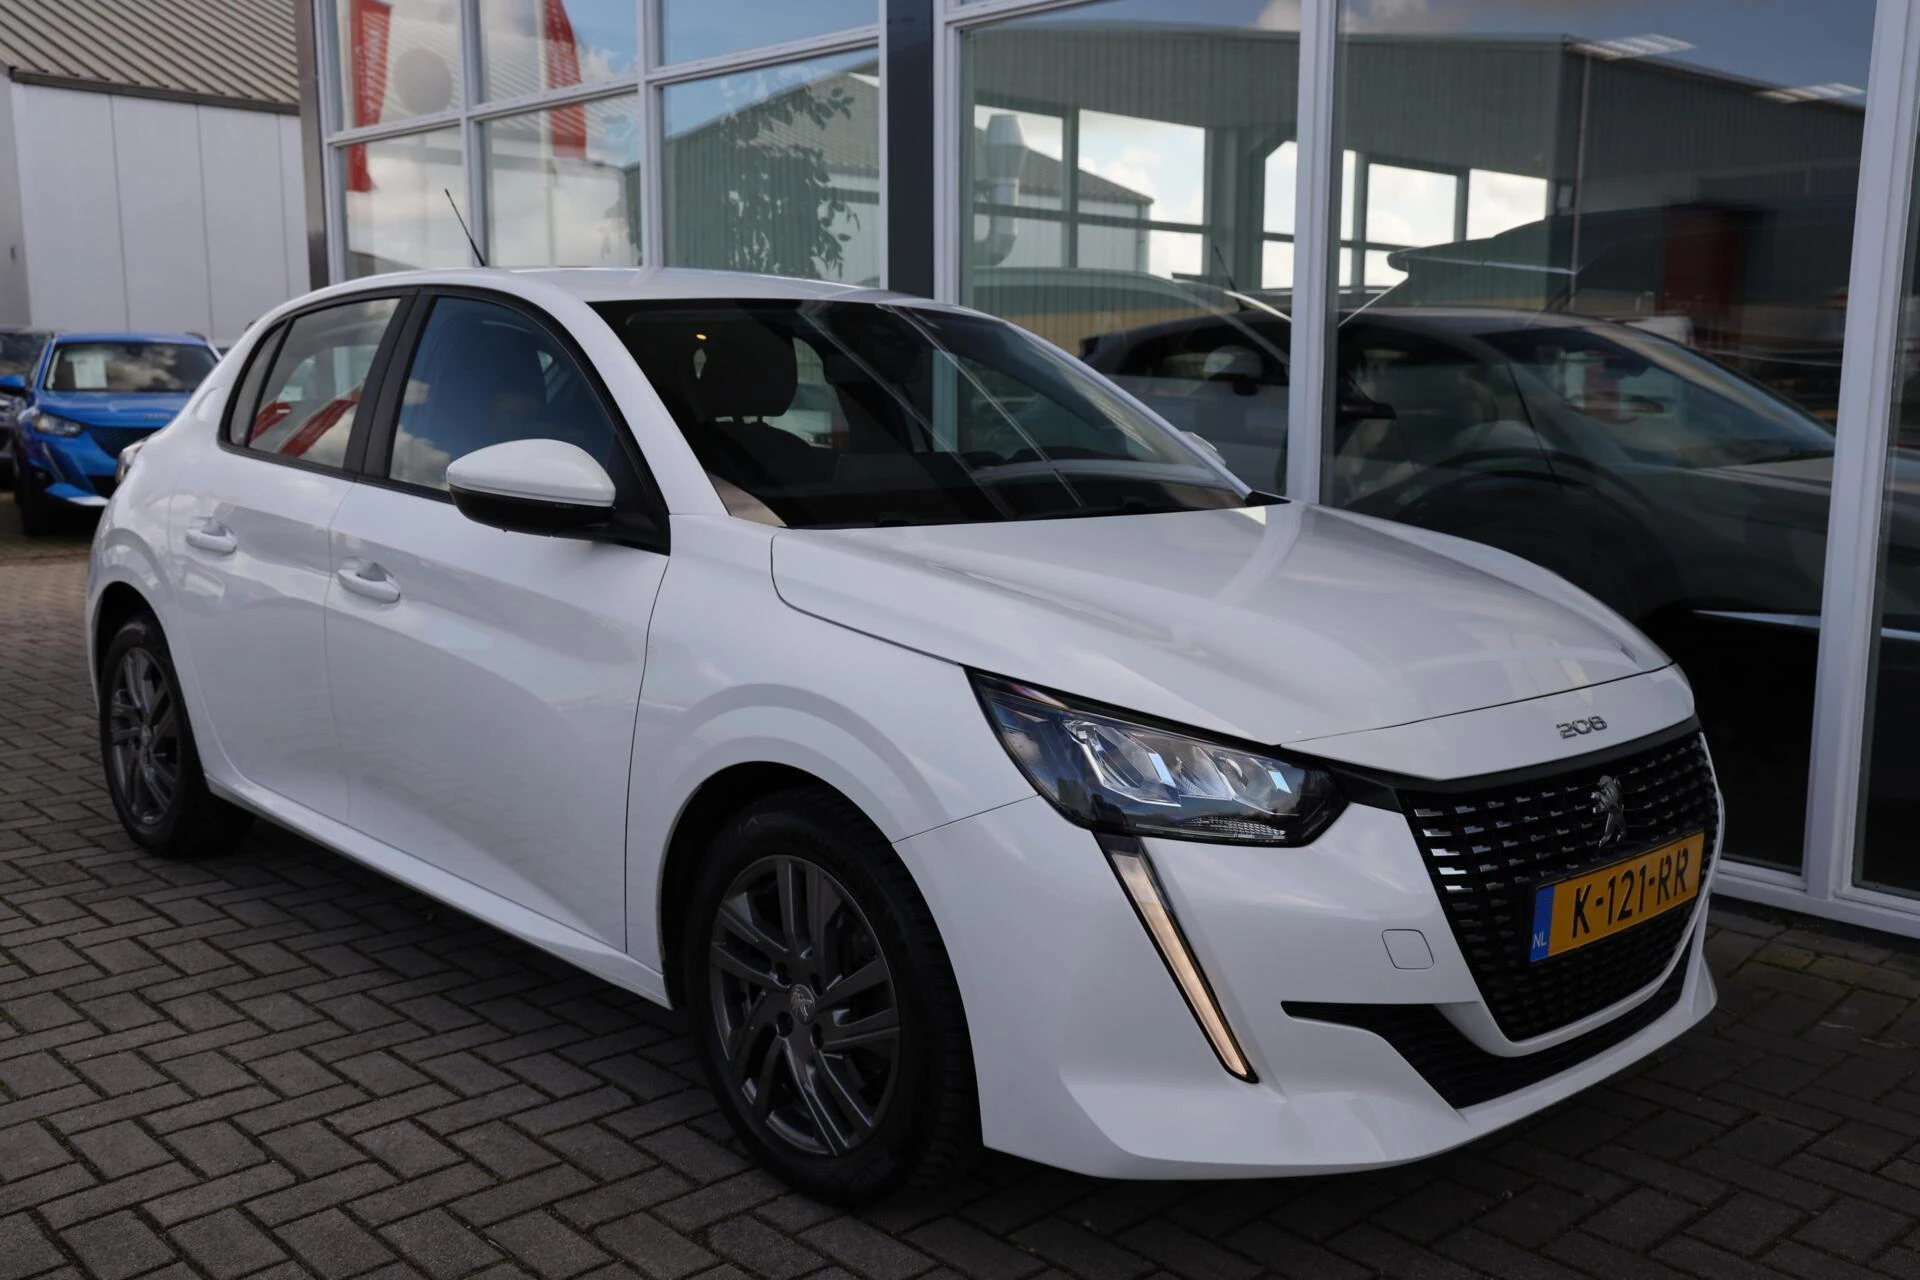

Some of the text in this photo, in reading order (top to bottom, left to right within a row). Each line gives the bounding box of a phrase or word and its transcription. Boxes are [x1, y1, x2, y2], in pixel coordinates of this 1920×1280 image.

[1556, 716, 1607, 739] 208
[1572, 848, 1689, 938] K-121-RR
[1533, 931, 1547, 949] NL
